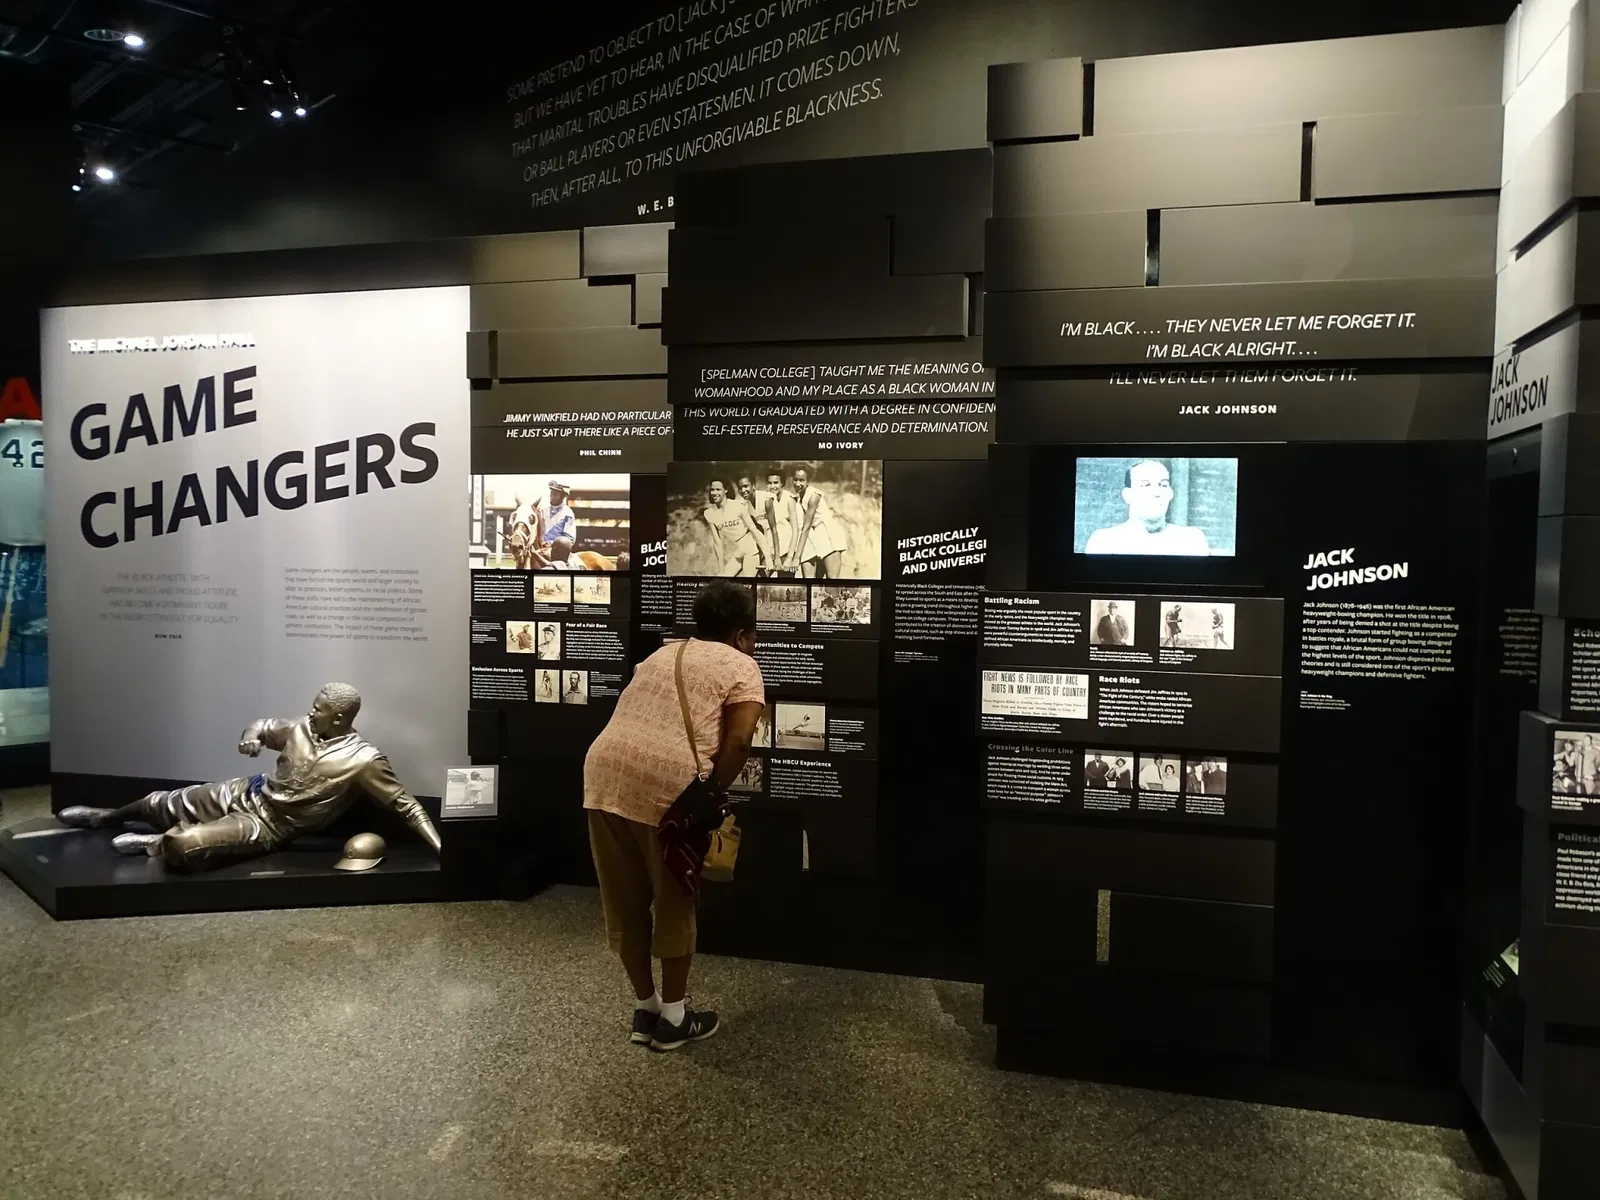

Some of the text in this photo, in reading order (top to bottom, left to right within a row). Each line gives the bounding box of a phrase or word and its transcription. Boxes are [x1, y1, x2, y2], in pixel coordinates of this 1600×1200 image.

[537, 55, 585, 89] PRETEND
[589, 46, 604, 65] TO
[606, 22, 653, 57] OBJECT
[657, 13, 674, 35] TO
[514, 111, 533, 128] BUT
[536, 102, 552, 119] WE
[555, 85, 584, 109] HAVE
[586, 75, 608, 98] YET
[611, 68, 627, 88] TO
[630, 52, 665, 81] HEAR,
[668, 46, 681, 64] IN
[685, 31, 712, 56] THE
[714, 13, 751, 45] CASE
[755, 4, 776, 28] OF
[512, 134, 538, 156] THAT
[539, 116, 584, 147] MARITAL
[587, 91, 647, 129] TROUBLES
[650, 76, 684, 105] HAVE
[687, 38, 783, 91] DISQUALIFIED
[787, 18, 832, 53] PRIZE
[523, 32, 900, 182] OR BALL PLAYERS OR EVEN STATESMEN. IT COMES DOWN,
[531, 78, 883, 208] THEN, AFTER ALL, TO THIS UNFORGIVABLE BLACKNESS.
[637, 203, 650, 216] W.
[653, 199, 663, 211] E.
[1060, 322, 1082, 336] I'M
[1166, 319, 1208, 334] THEY
[1209, 317, 1262, 332] NEVER
[1265, 316, 1296, 331] LET
[1298, 315, 1325, 330] ME
[1327, 313, 1396, 330] FORGET
[1397, 313, 1416, 328] IT.
[1146, 344, 1169, 359] I'M
[1171, 342, 1224, 358] BLACK
[701, 362, 969, 382] [SPELMAN COLLEGE] TAUGHT ME THE MEANING
[1137, 370, 1187, 384] NEVER
[1190, 370, 1220, 383] LET
[1225, 369, 1268, 383] THEM
[1272, 367, 1338, 382] FORGET
[1340, 367, 1357, 381] IT.
[1492, 354, 1520, 394] JACK
[694, 381, 995, 398] WOMANHOOD AND MY PLACE AS A BLACK WOMAN IN
[1491, 375, 1549, 426] JOHNSON
[70, 365, 257, 461] GAME
[503, 410, 672, 423] JIMMY WINKFIELD HAD NO PARTICULAR
[683, 402, 996, 418] THIS WORLD. I GRADUATED WITH A DEGREE IN CONFIDEN
[1179, 405, 1277, 415] JACK JOHNSON
[506, 426, 672, 438] HE JUST SAT UP THERE LIKE A PIECE OF
[702, 421, 989, 436] SELF-ESTEEM, PERSEVERANCE AND DETERMINATION.
[80, 422, 439, 548] CHANGERS
[897, 526, 979, 549] HISTORICALLY
[640, 540, 667, 554] BLAC
[899, 547, 936, 562] BLACK
[1303, 547, 1355, 569] JACK
[901, 562, 928, 575] AND
[1306, 562, 1409, 591] JOHNSON
[984, 597, 1013, 606] Battling
[984, 672, 1079, 685] FIGHT NEWS IS FOLLOWED BY RACE
[1119, 676, 1140, 684] Riots
[991, 684, 1087, 697] RIOTS IN MANY PARTS OF COUNTRY
[988, 744, 1020, 753] Crossing
[800, 760, 832, 768] Experience
